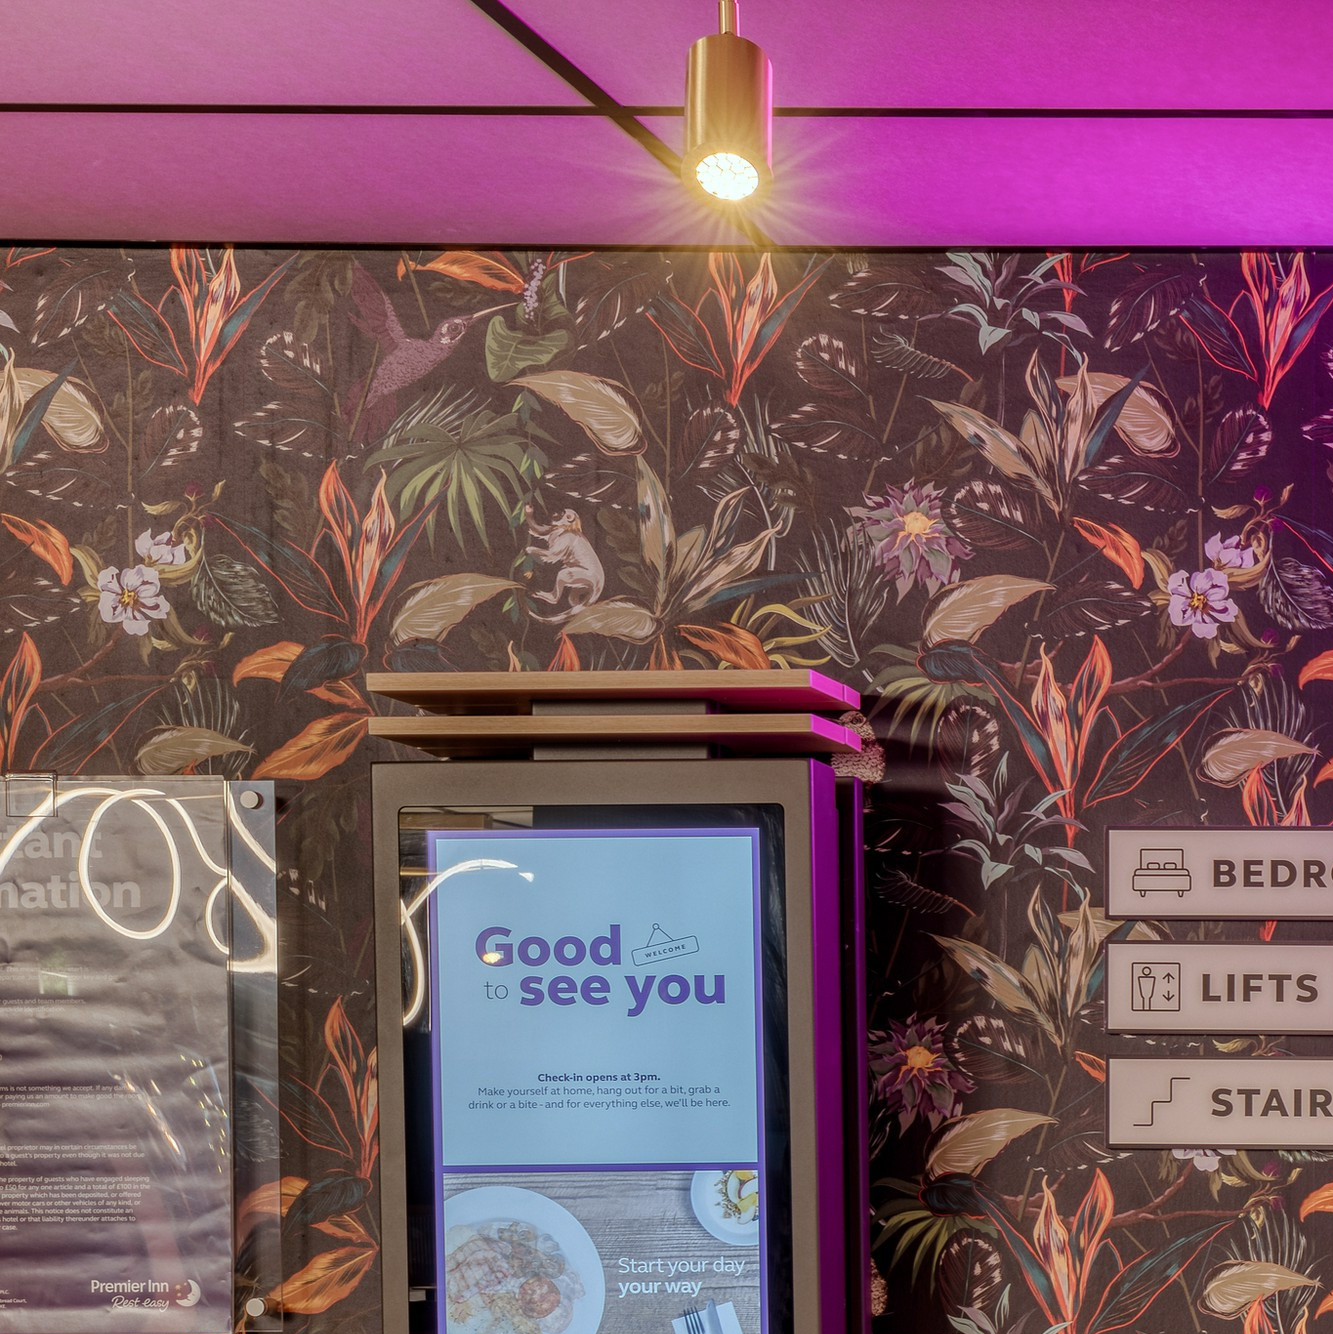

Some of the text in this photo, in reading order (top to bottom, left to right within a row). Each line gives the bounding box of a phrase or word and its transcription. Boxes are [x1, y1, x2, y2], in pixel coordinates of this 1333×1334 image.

[476, 924, 621, 966] Good
[644, 944, 686, 958] WELCOME
[484, 975, 725, 1017] to see you
[1202, 973, 1318, 1003] LIFTS
[538, 1072, 660, 1084] Check-in opens at 3pm.
[478, 1087, 504, 1096] Make
[507, 1086, 548, 1098] yourself
[550, 1086, 562, 1095] at
[563, 1086, 594, 1096] home,
[597, 1085, 622, 1097] hang
[624, 1085, 642, 1094] out
[645, 1085, 659, 1094] for
[670, 1085, 686, 1095] bit,
[688, 1084, 711, 1096] grab
[468, 1100, 494, 1109] drink
[517, 1100, 538, 1109] bite
[545, 1099, 564, 1108] and
[566, 1099, 581, 1108] for
[583, 1099, 638, 1110] everything
[638, 1098, 663, 1109] else,
[665, 1098, 688, 1107] we'll
[691, 1098, 703, 1107] be
[706, 1098, 730, 1107] here.
[618, 1256, 745, 1276] Start your day
[91, 1280, 168, 1293] Premier Inn
[618, 1282, 702, 1298] your way
[112, 1296, 169, 1312] Rest easy
